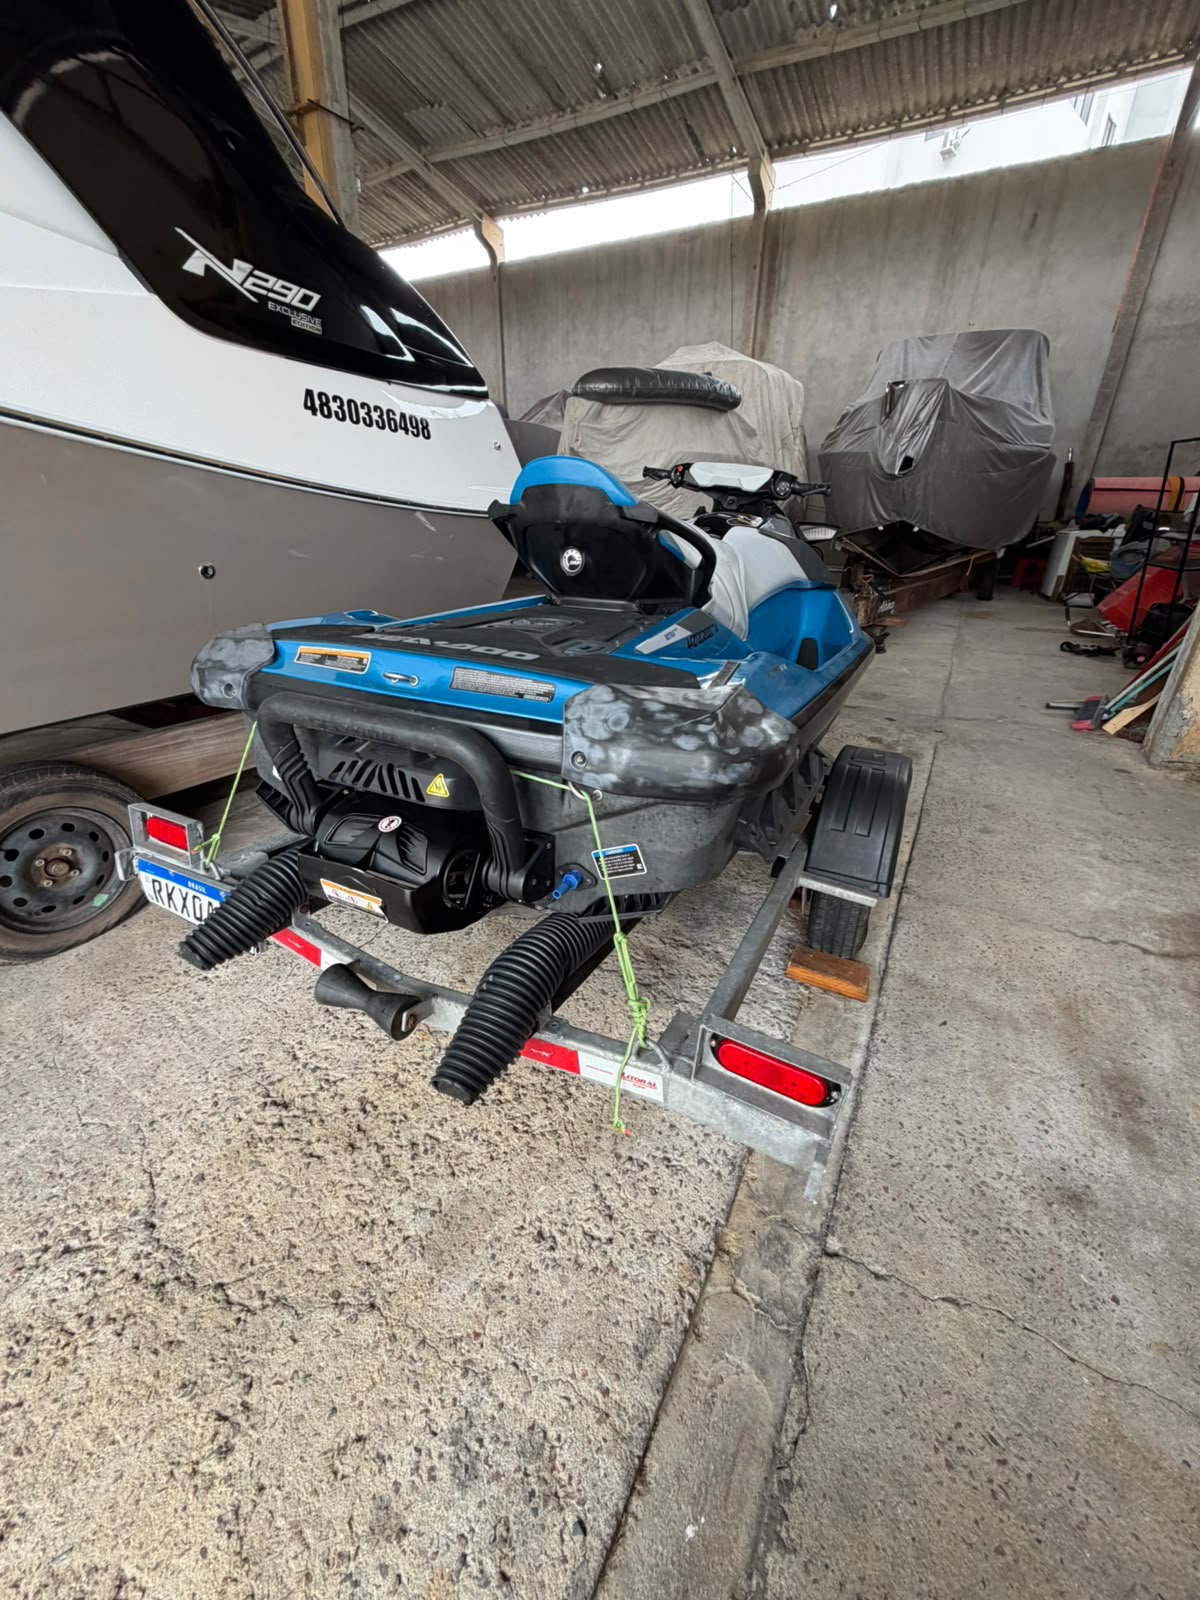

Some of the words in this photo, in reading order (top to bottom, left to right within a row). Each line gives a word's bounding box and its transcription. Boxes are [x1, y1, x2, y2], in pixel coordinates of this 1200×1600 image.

[267, 301, 322, 326] EXCLUSIVE
[292, 319, 322, 334] EDITION
[303, 388, 432, 440] 4830336498
[187, 880, 208, 894] BRASIL
